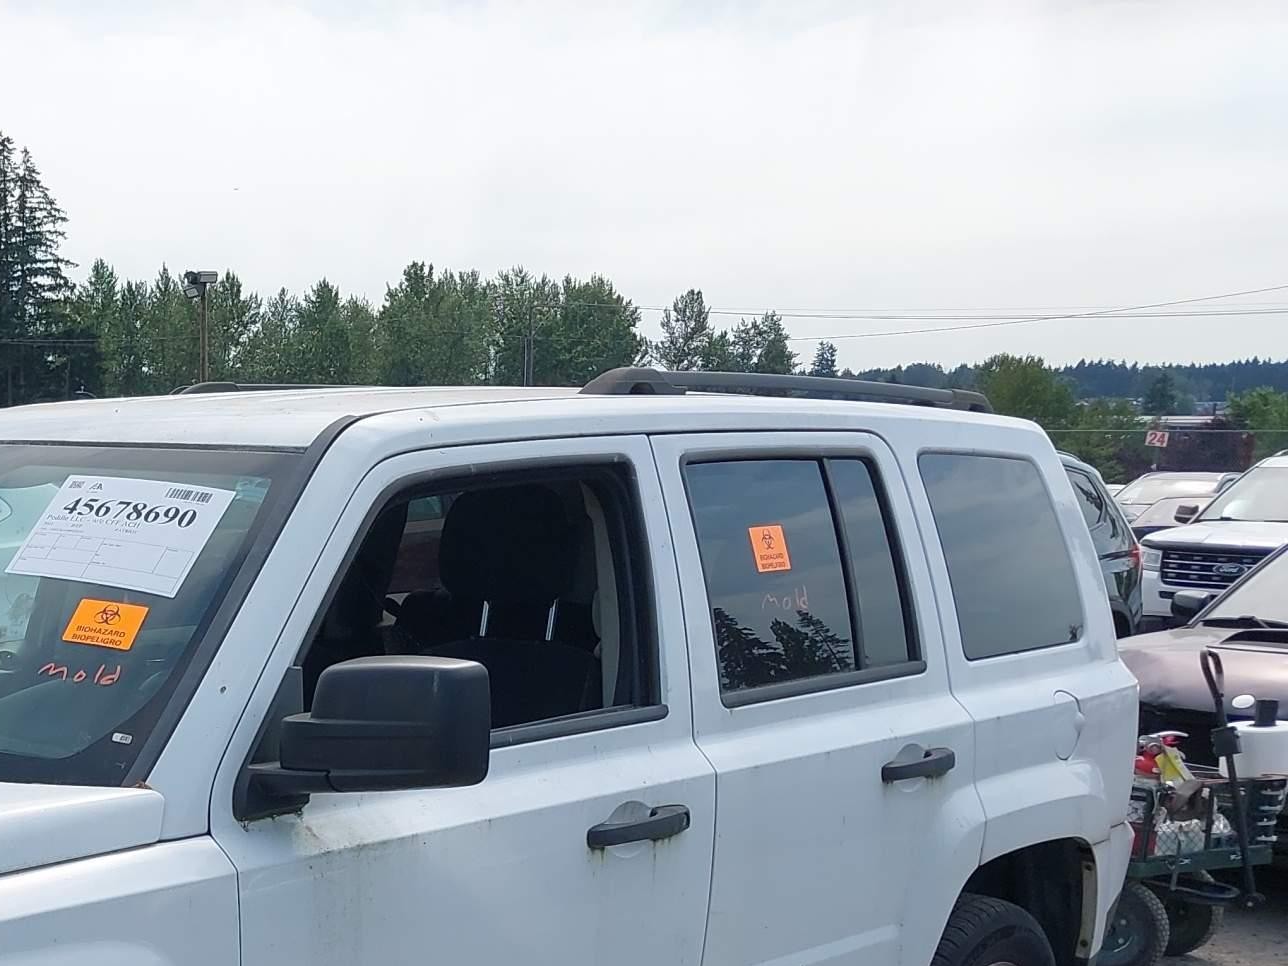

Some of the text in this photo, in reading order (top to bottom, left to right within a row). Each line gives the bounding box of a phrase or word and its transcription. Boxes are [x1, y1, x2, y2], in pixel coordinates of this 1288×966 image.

[1148, 432, 1167, 446] 24
[63, 497, 197, 528] 45678690
[76, 625, 126, 638] BIOHAZARD
[71, 633, 122, 647] BIOPELIGRO
